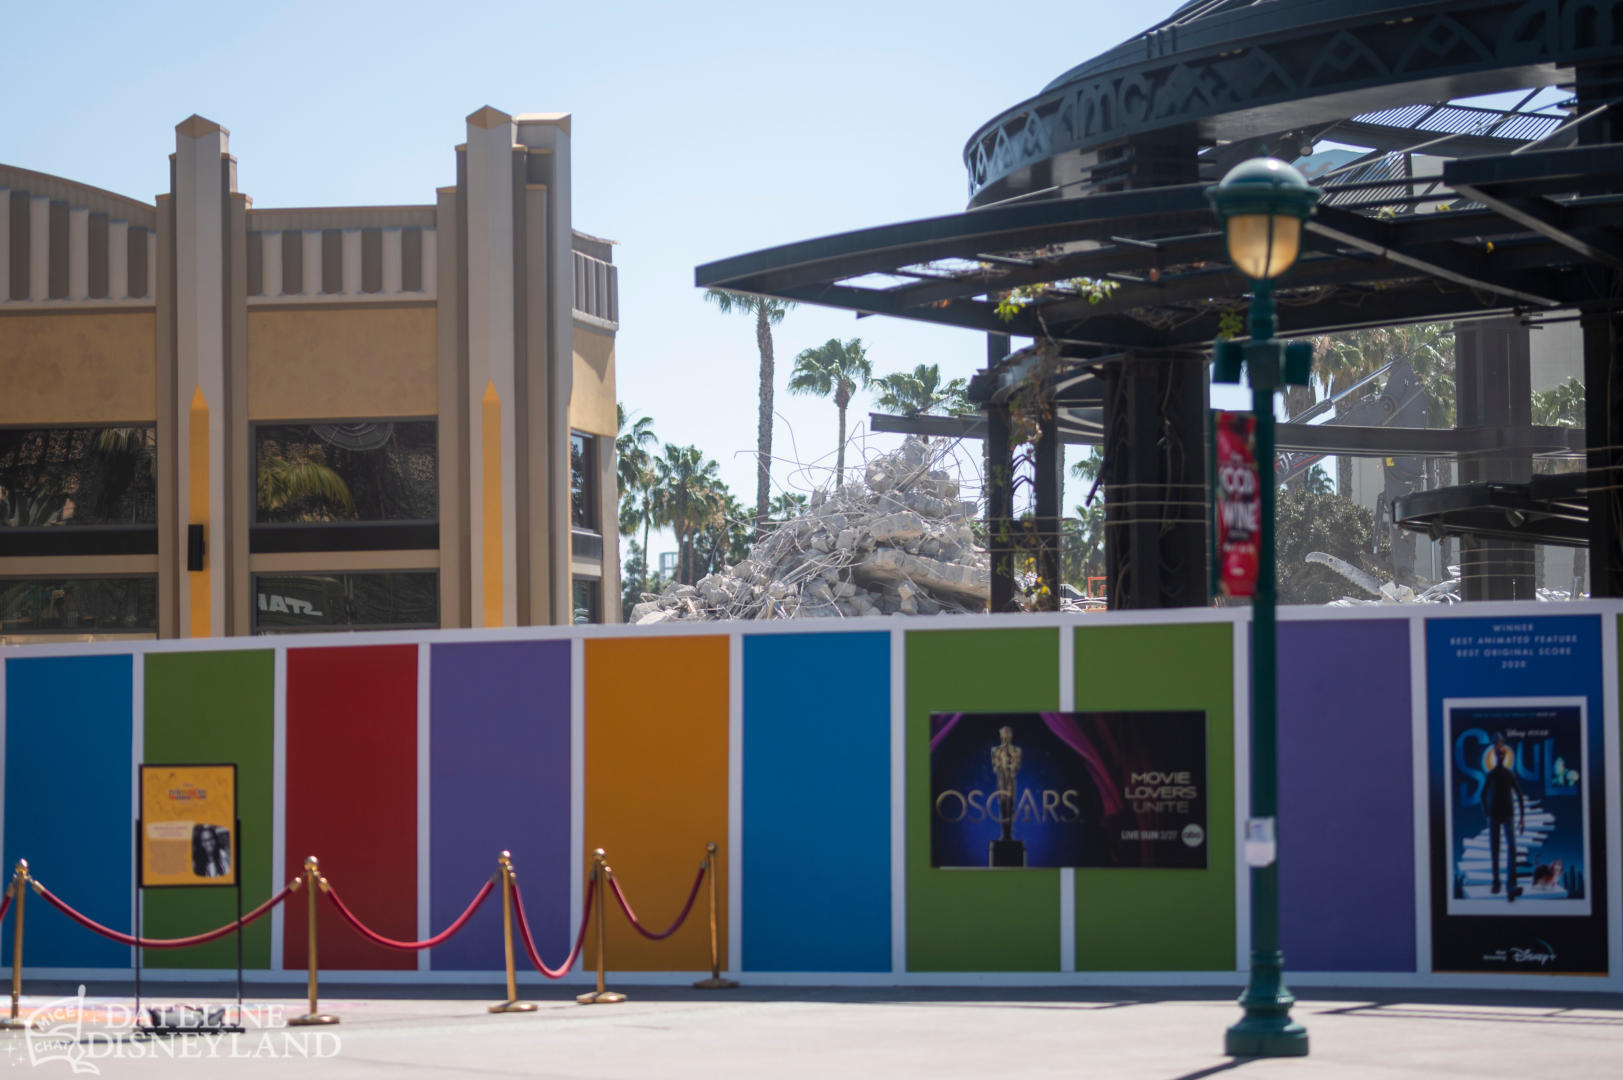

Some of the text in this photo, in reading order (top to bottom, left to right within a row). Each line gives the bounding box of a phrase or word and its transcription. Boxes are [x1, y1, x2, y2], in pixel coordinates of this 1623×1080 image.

[1492, 623, 1534, 632] WINNER
[1450, 634, 1577, 646] BEST ANIMATED FEATURE
[1456, 646, 1571, 658] BEST ORIGINAL SCORE
[1501, 660, 1527, 669] 2020
[1131, 771, 1191, 785] MOVIE
[1124, 786, 1197, 799] LOVERS
[936, 788, 1082, 823] OSCARS
[1132, 800, 1190, 814] UNITE
[1120, 830, 1139, 840] LIVE
[1140, 830, 1159, 840] SUN
